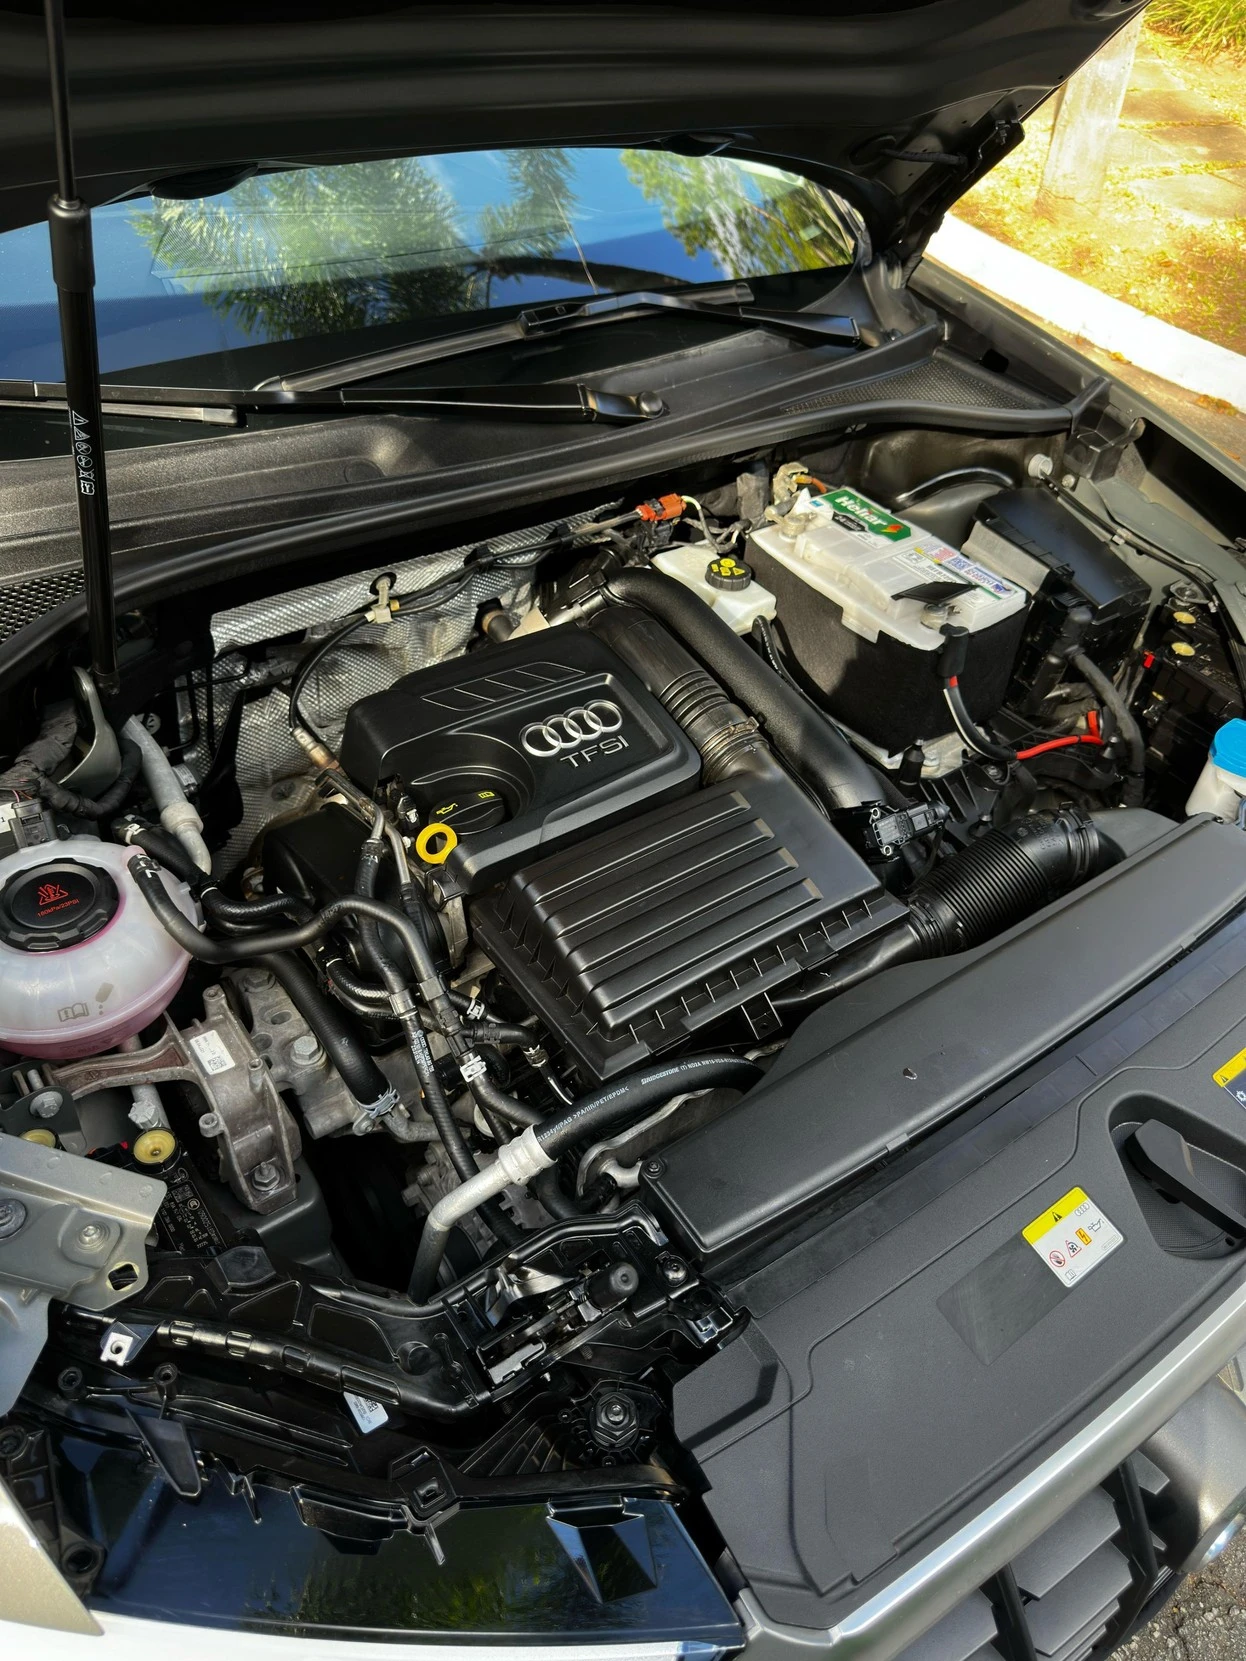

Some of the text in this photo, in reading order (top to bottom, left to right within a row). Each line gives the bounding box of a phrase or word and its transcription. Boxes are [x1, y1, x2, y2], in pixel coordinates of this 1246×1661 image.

[834, 496, 888, 526] Heliar
[560, 735, 629, 768] TFSI
[640, 1067, 680, 1085] BRIDGESTONE
